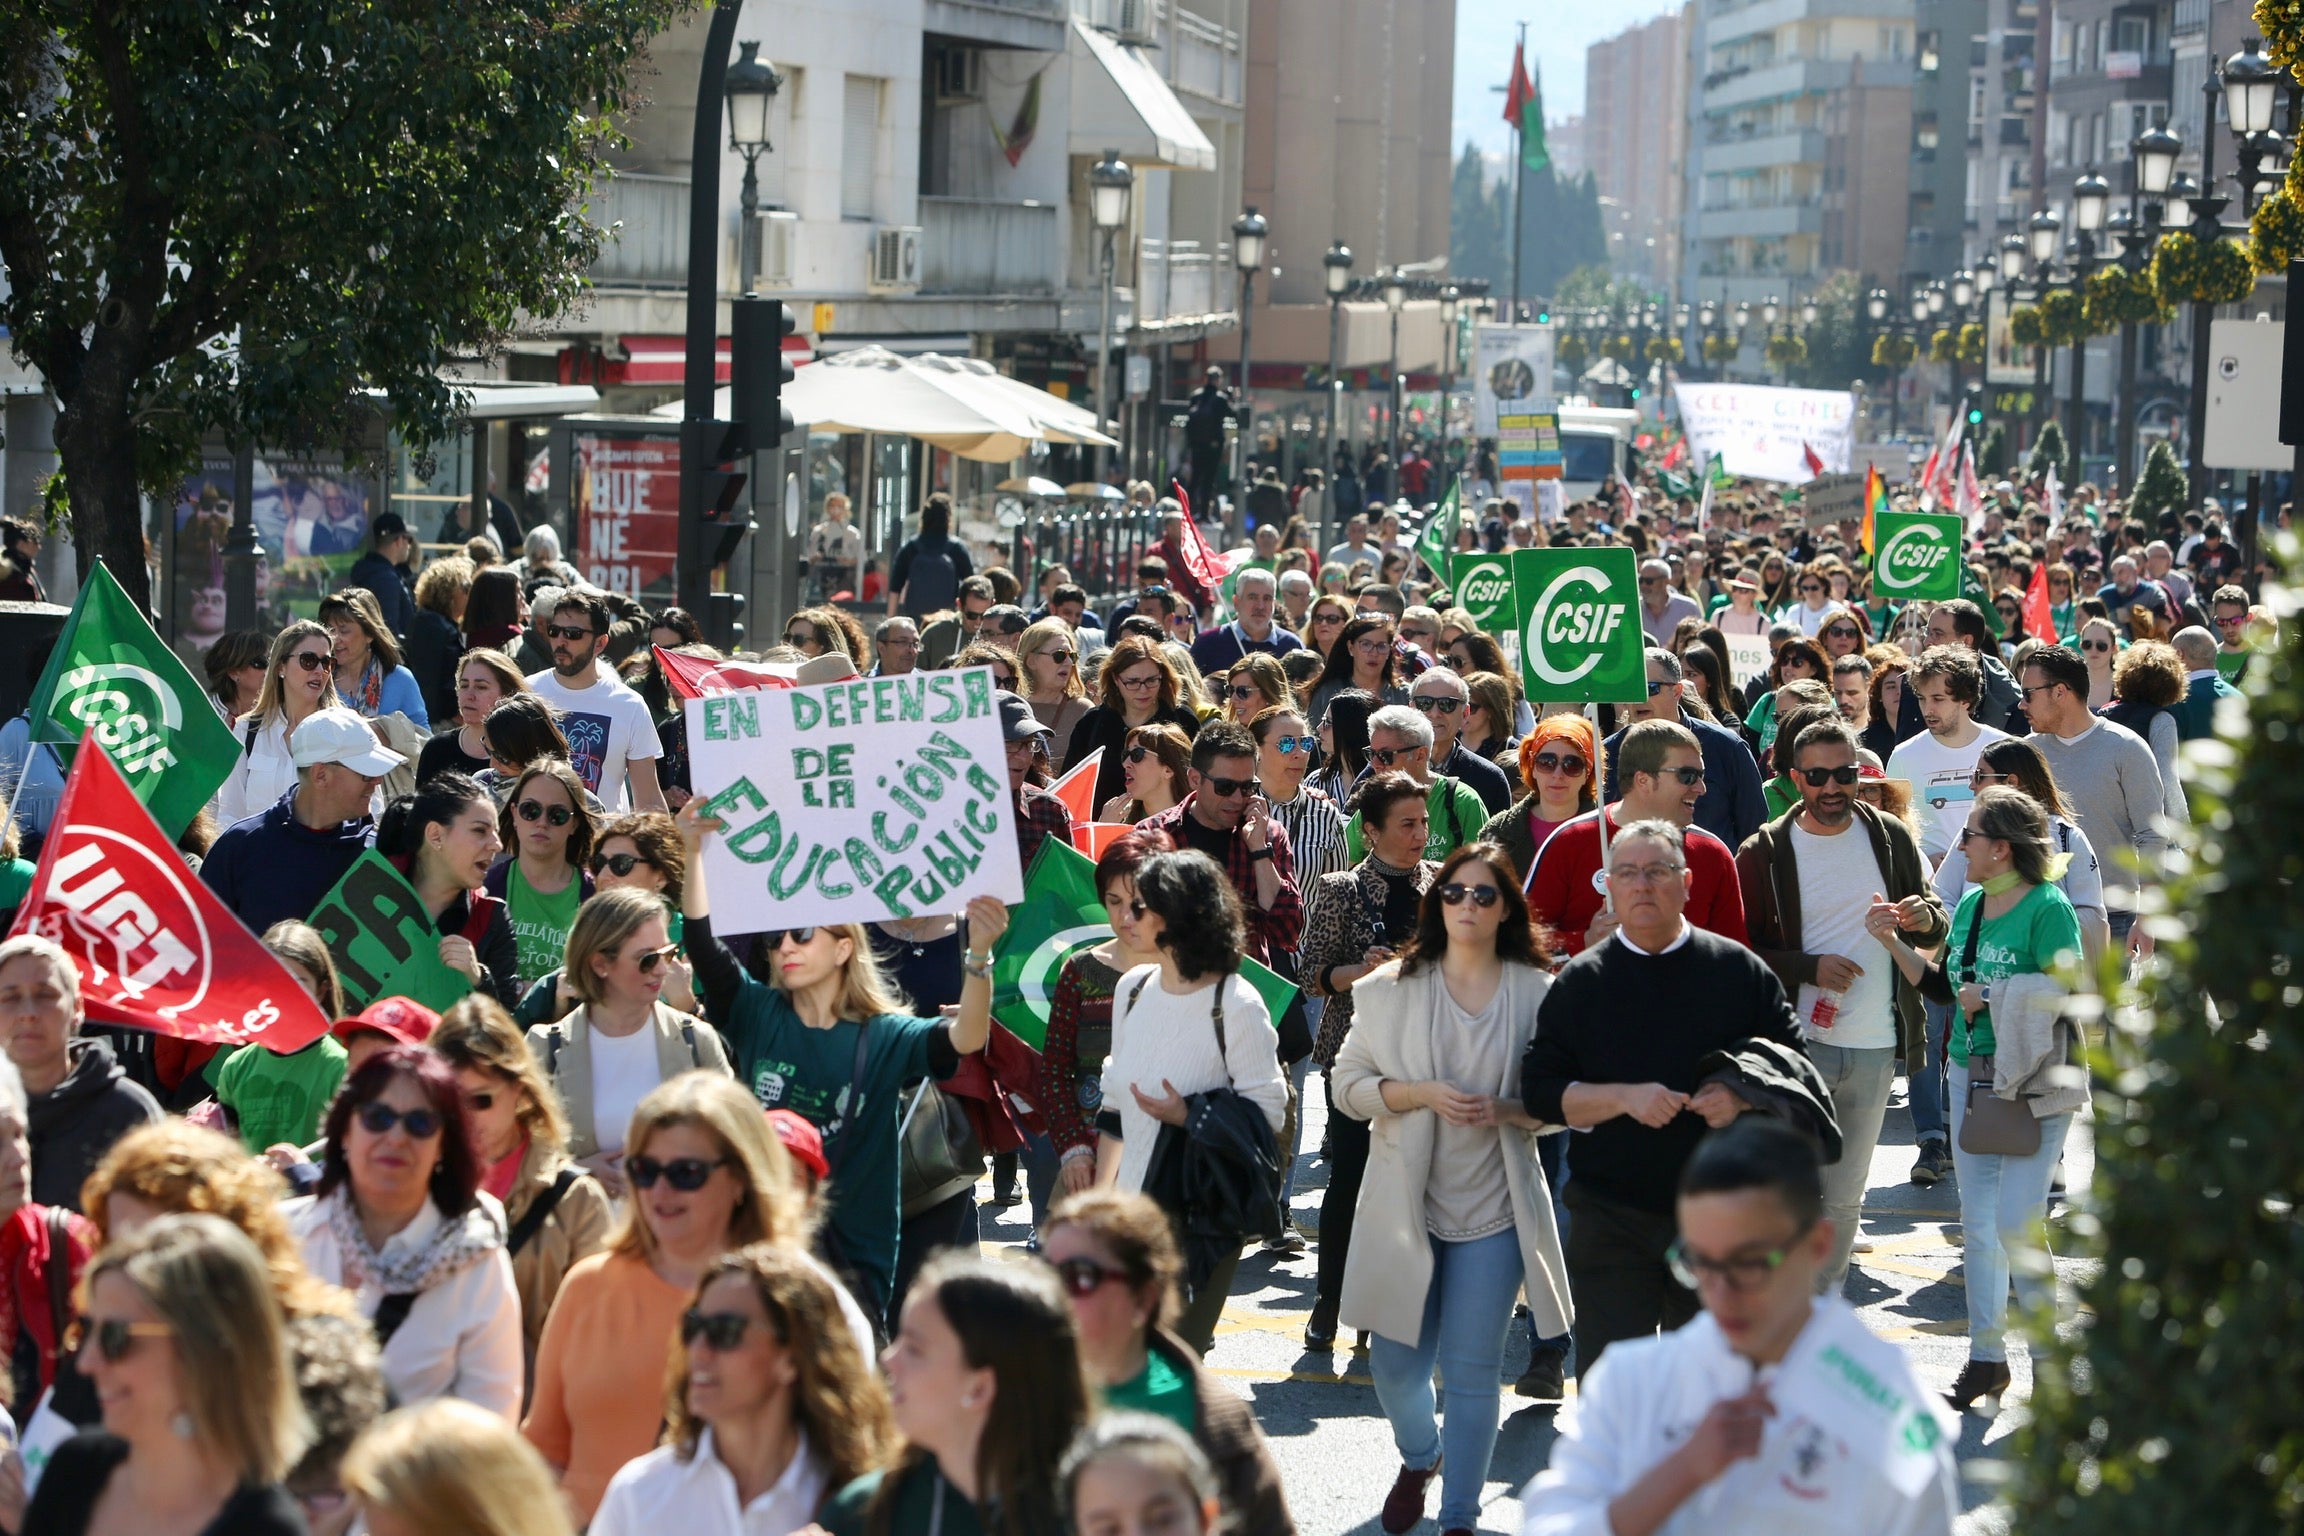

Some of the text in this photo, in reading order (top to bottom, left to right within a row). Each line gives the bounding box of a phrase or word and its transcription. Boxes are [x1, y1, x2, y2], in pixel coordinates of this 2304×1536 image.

[591, 469, 651, 514] BUE
[1893, 542, 1950, 569] CSIF
[1466, 579, 1513, 602] CSIF
[1547, 602, 1626, 645] CSIF
[704, 670, 992, 740] EN DEFENSA
[69, 690, 179, 774] CSIF
[791, 743, 855, 780] DE
[802, 779, 855, 808] LA
[45, 842, 198, 999] UGT
